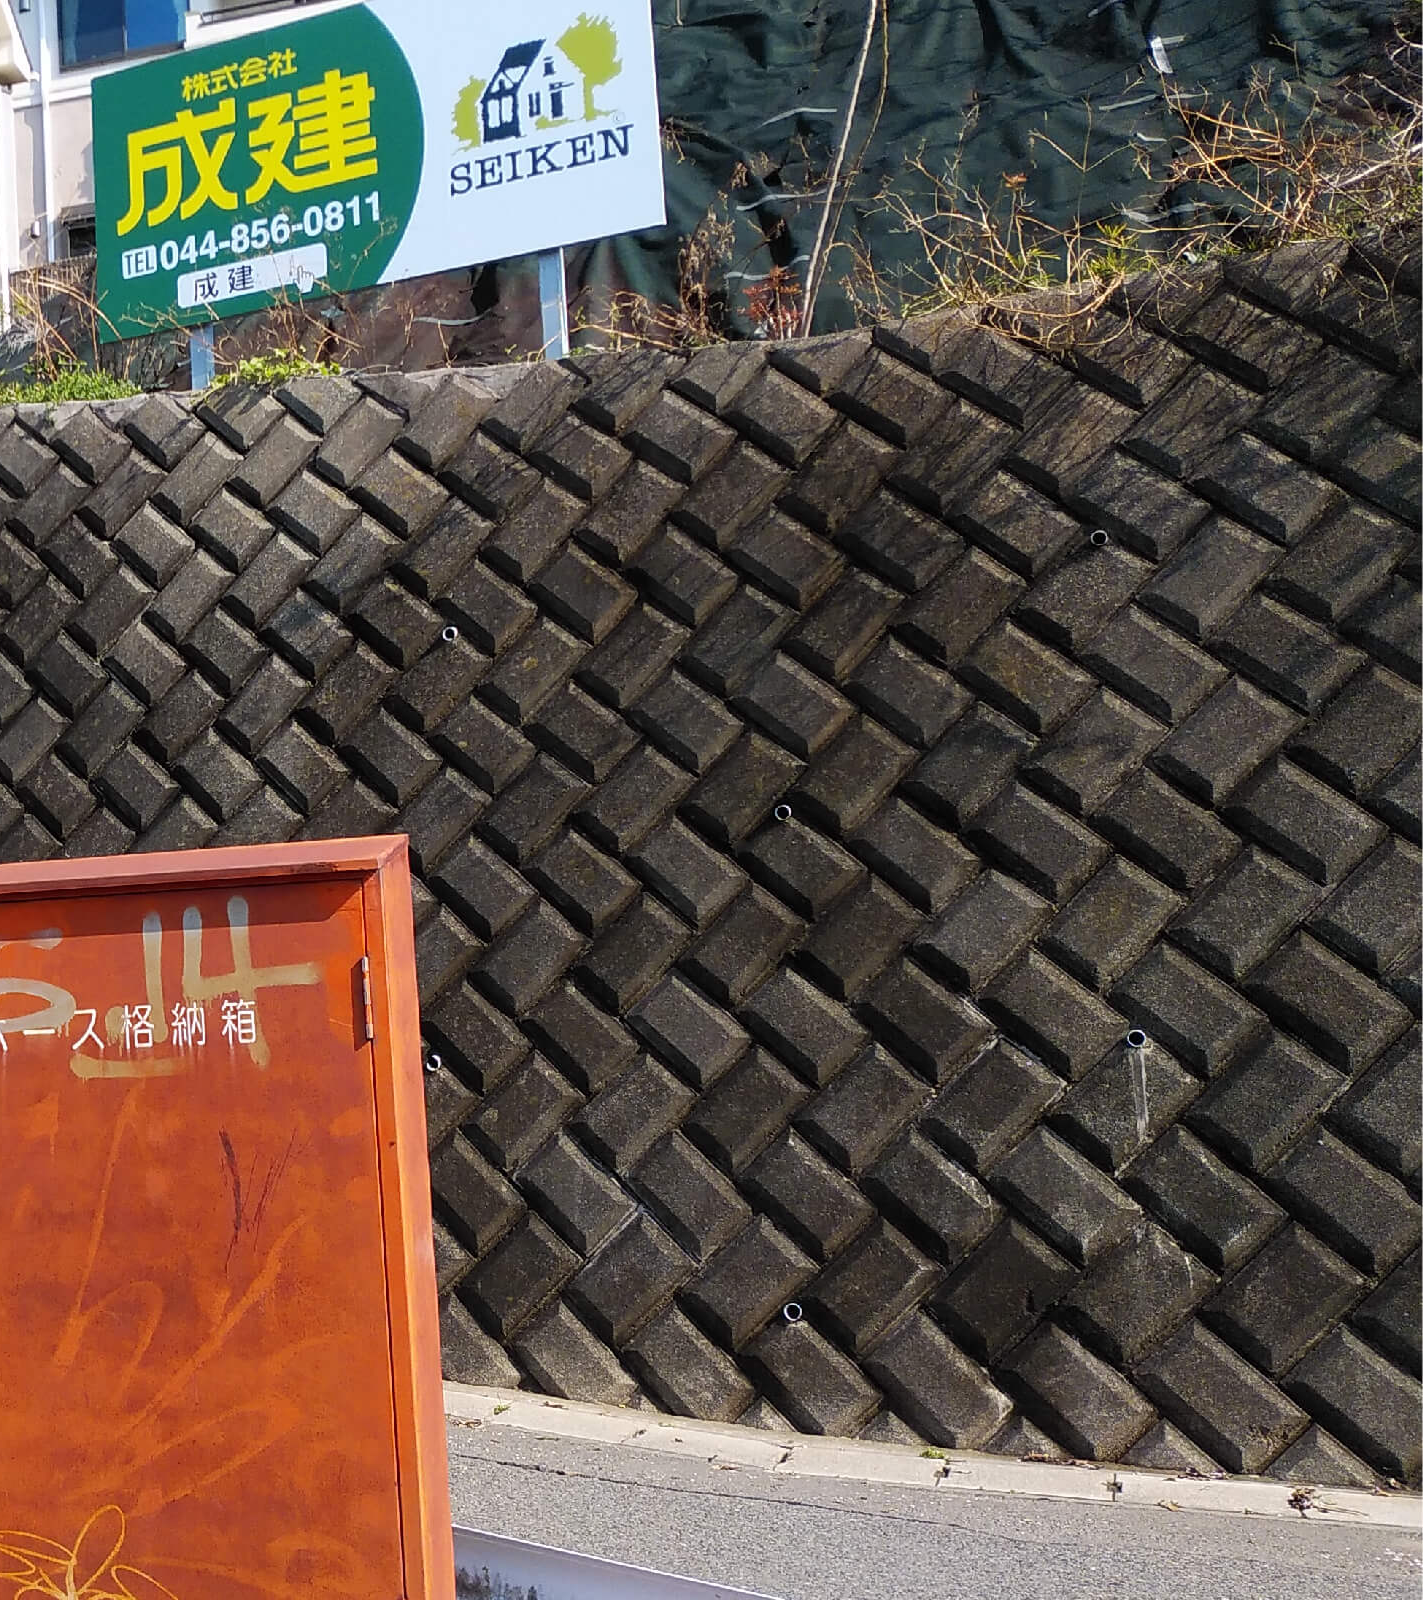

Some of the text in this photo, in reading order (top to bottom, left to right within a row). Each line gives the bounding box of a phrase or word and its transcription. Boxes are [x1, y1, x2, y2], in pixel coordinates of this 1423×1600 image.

[181, 48, 298, 102] 株式会社
[116, 68, 380, 237] 成建
[450, 123, 634, 197] SEIKEN
[123, 190, 380, 278] TEL 044-856-0811
[194, 264, 255, 302] 成建
